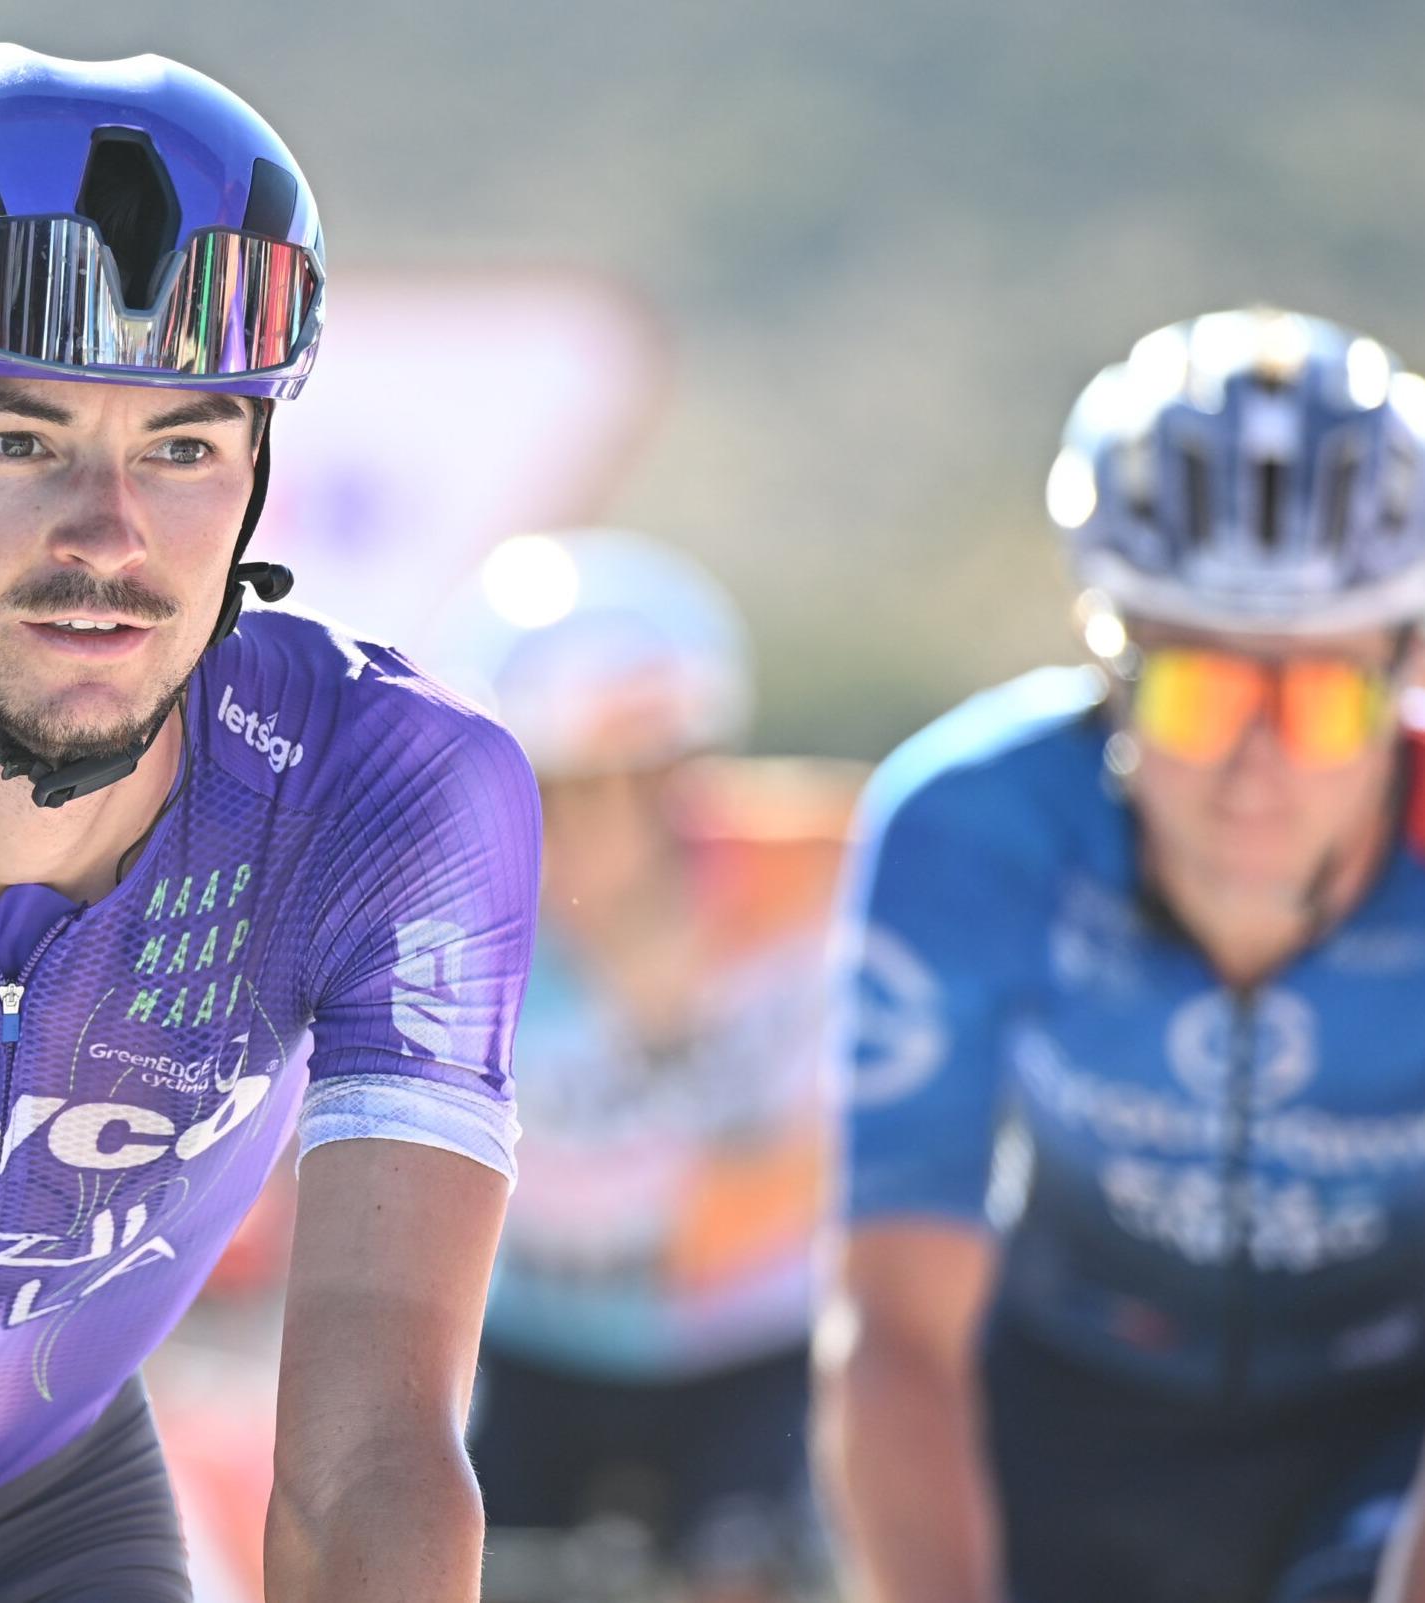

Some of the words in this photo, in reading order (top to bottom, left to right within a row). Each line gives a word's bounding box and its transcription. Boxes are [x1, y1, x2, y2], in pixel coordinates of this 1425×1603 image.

[144, 863, 251, 921] MAAP
[133, 919, 250, 974] MAAP
[88, 1043, 214, 1083] GreenEDGE
[141, 1072, 209, 1094] cycling
